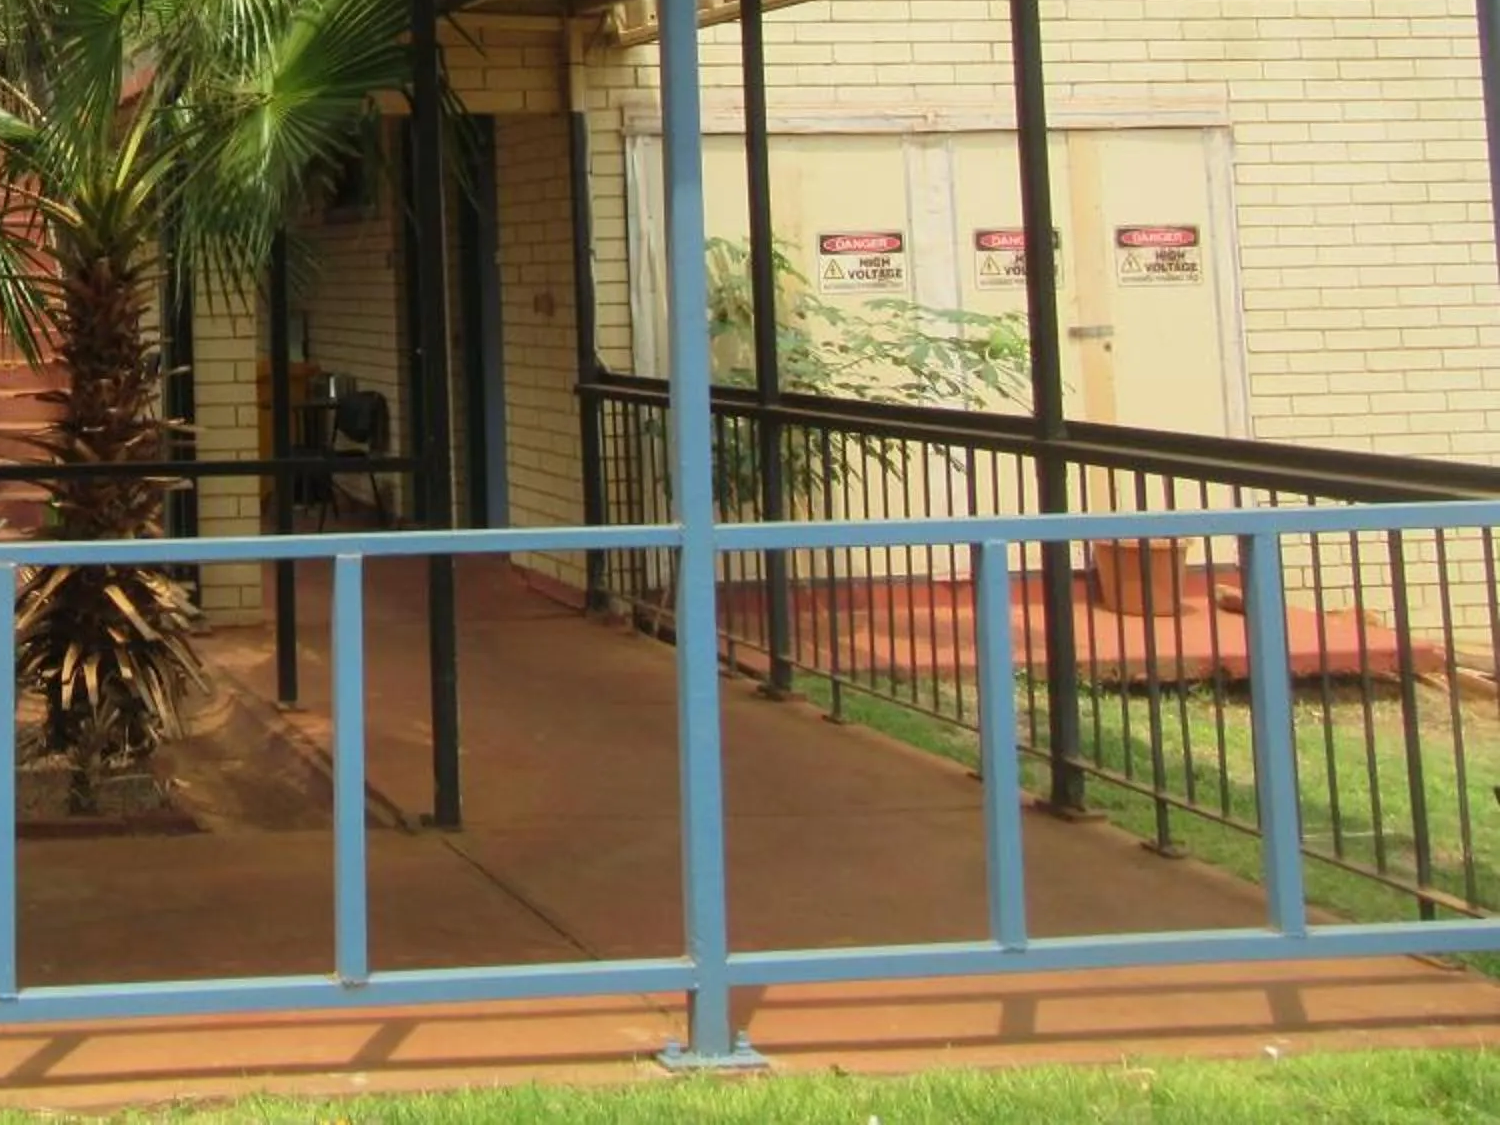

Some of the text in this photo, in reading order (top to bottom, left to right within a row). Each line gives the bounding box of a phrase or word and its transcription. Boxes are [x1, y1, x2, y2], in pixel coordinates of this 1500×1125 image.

[1131, 231, 1183, 244] DANGER
[835, 237, 888, 251] DANGER
[1155, 250, 1186, 261] HIGH
[859, 257, 891, 268] HIGH
[1144, 262, 1199, 272] VOLTAGE
[847, 268, 903, 280] VOLTAGE
